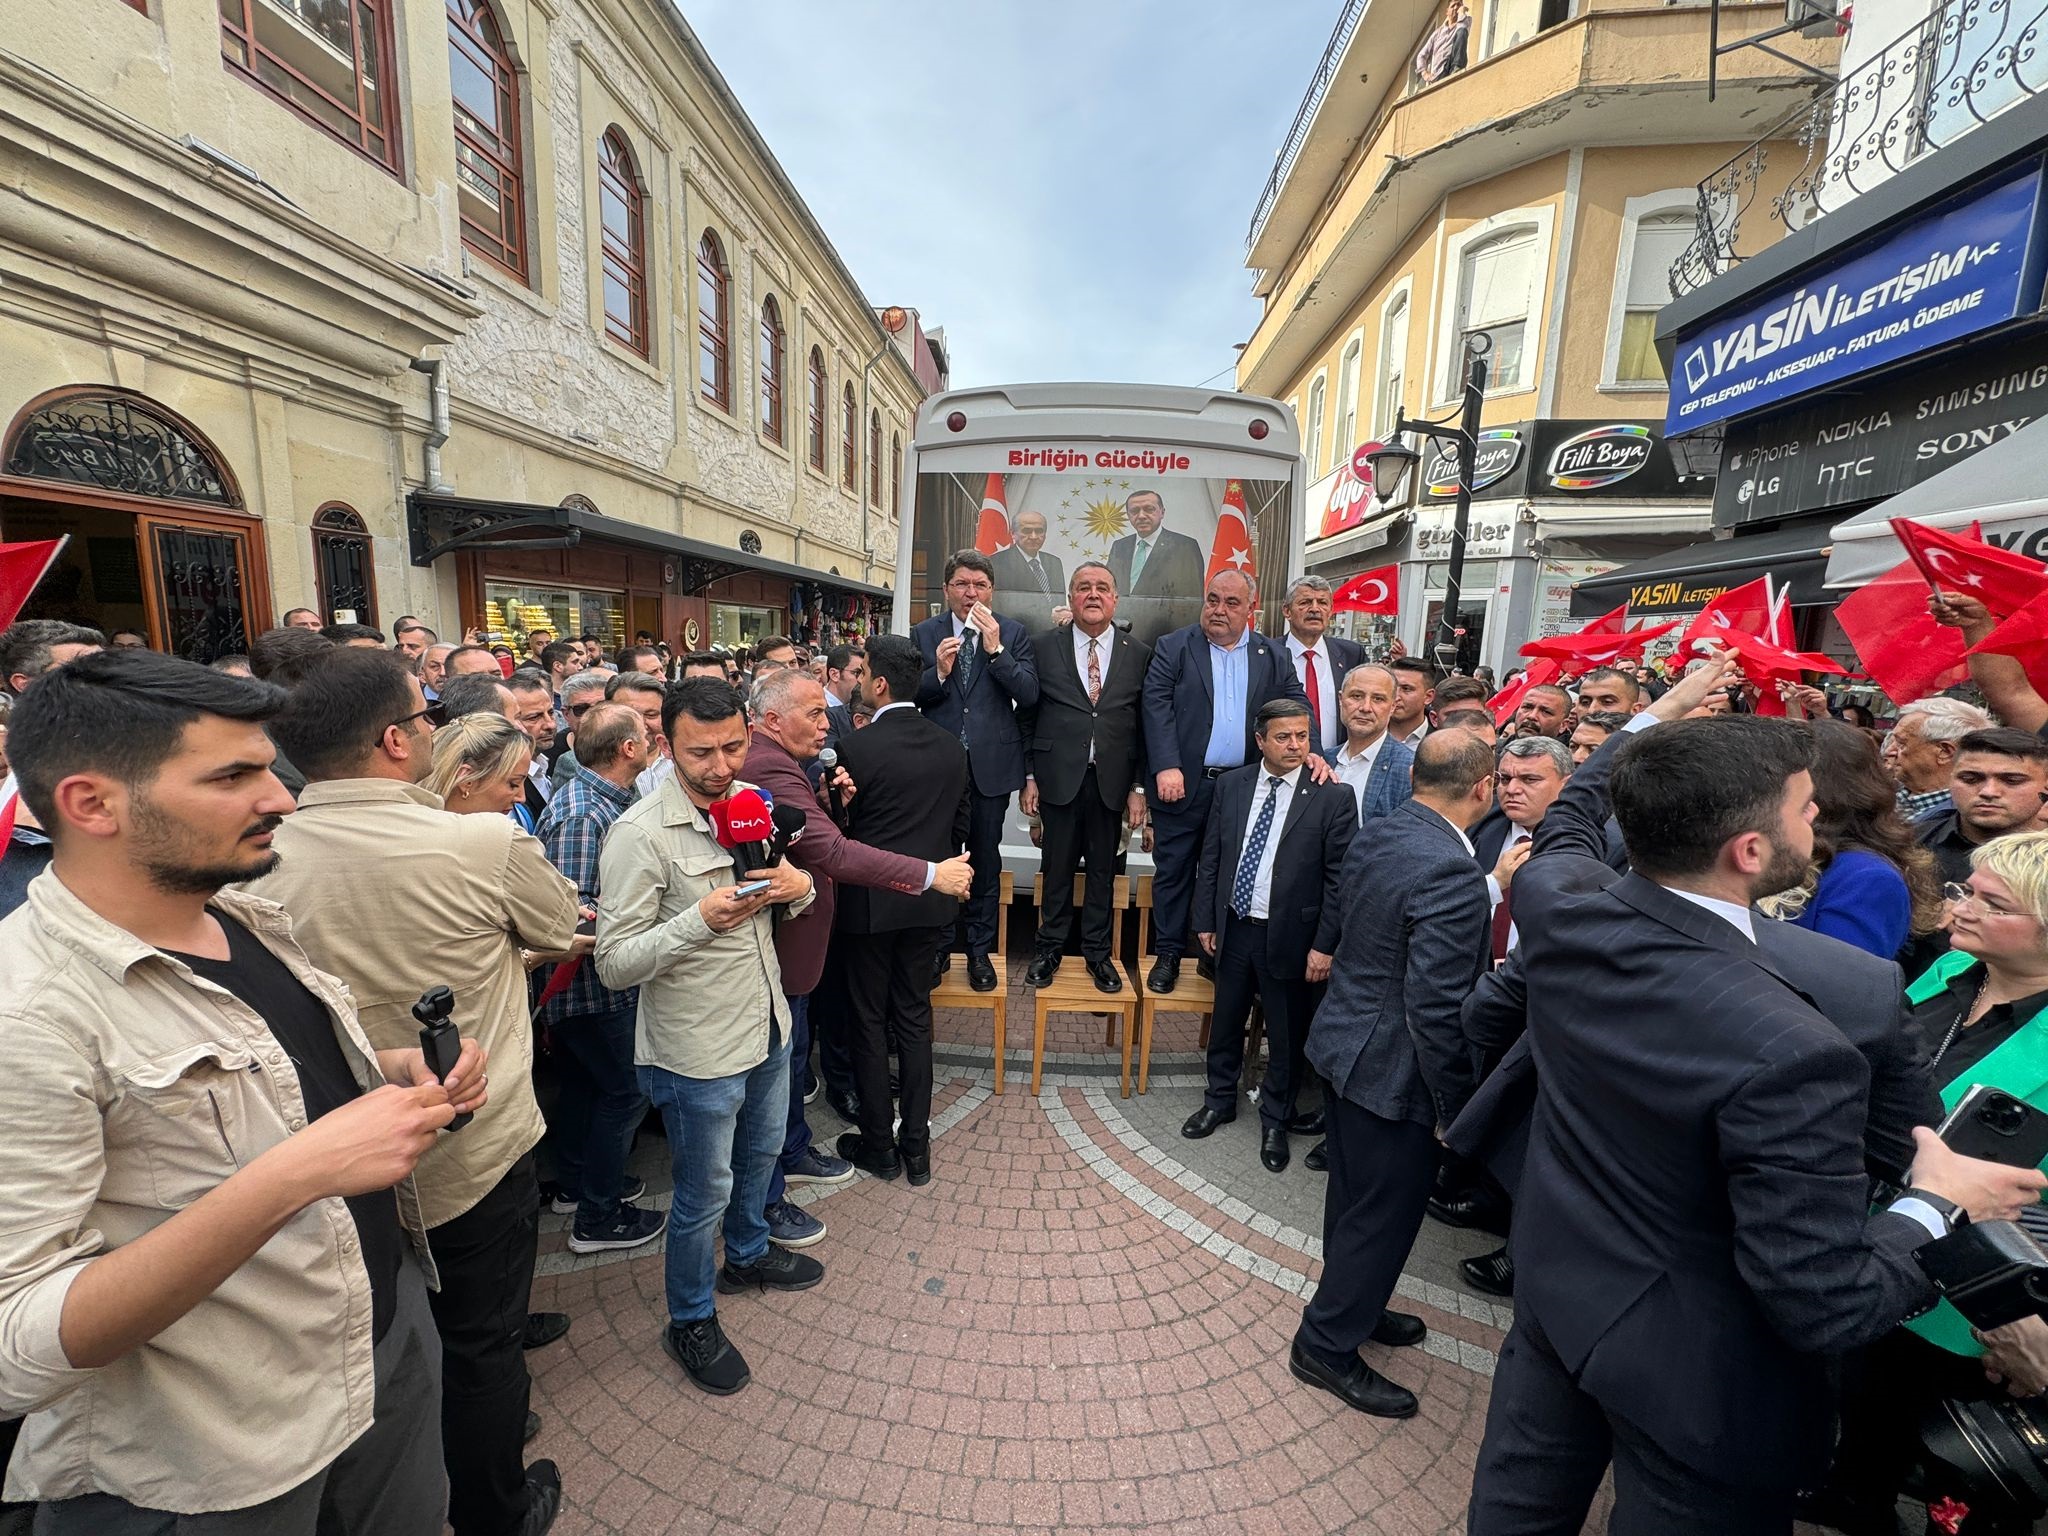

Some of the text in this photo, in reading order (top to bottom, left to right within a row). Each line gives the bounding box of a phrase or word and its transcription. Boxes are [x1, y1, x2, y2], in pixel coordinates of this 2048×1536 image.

[1711, 246, 1971, 378] YASİN İLETİŞİM
[1679, 397, 1700, 417] CEP
[1700, 377, 1757, 410] TELEFONU
[1763, 349, 1836, 386] AKSESUAR
[1846, 322, 1910, 355] FATURA
[1913, 288, 1985, 329] ÖDEME
[1915, 364, 2048, 421] SAMSUNG
[1816, 410, 1893, 447] NOKIA
[1916, 416, 2032, 461] SONY
[1008, 448, 1191, 475] Birliğin Gücüyle
[1475, 447, 1511, 472] oya
[1559, 442, 1645, 471] Filli Boya
[1746, 442, 1800, 470] iPhone
[1757, 476, 1781, 497] LG
[1416, 521, 1511, 550] giziler
[1630, 582, 1683, 607] YASİN
[730, 817, 766, 830] DHA
